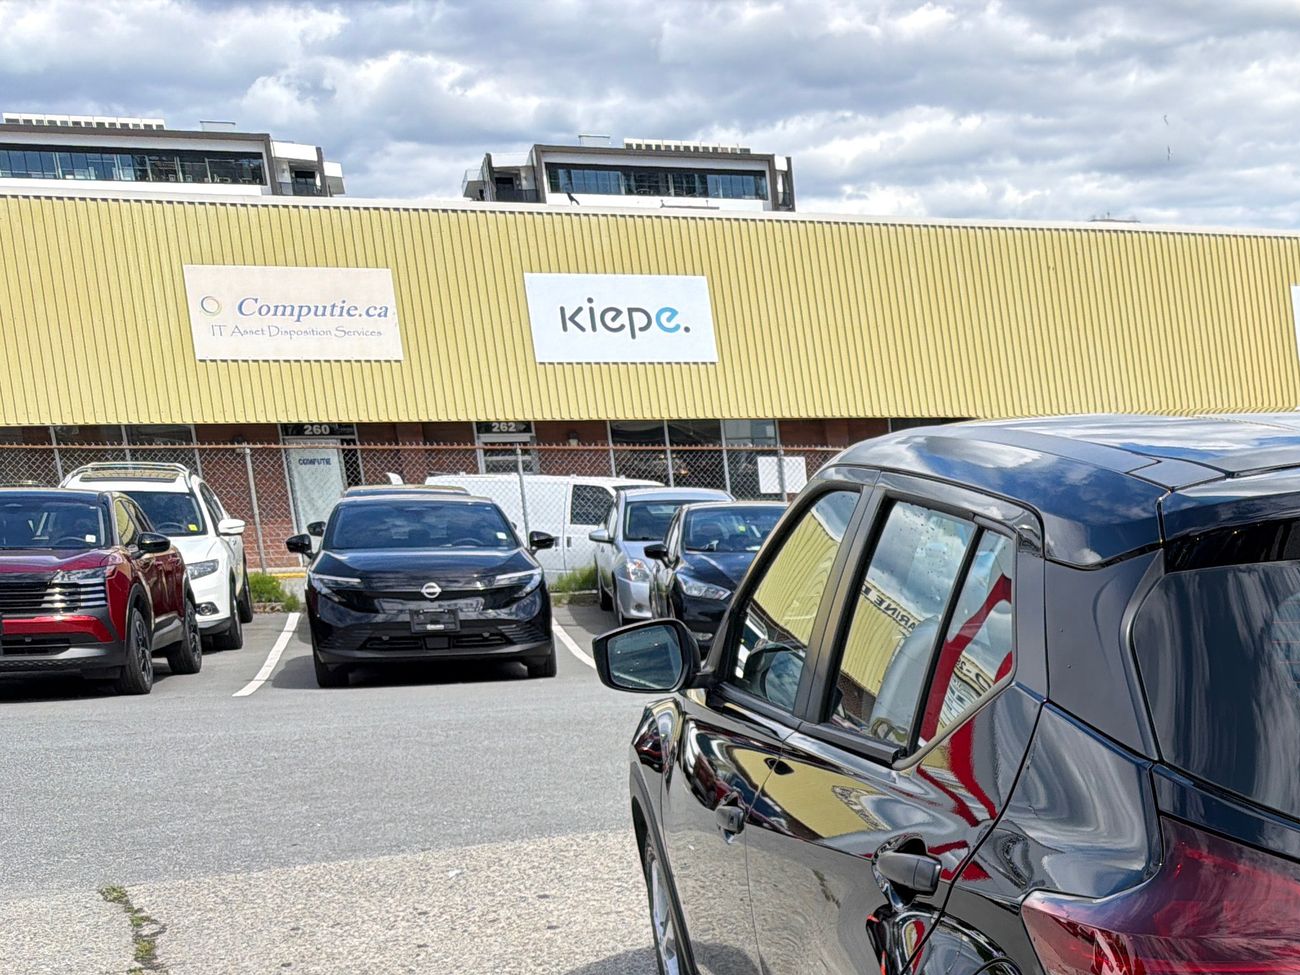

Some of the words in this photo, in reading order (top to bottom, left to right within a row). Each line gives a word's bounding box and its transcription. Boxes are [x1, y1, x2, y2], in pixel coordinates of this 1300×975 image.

[237, 297, 389, 323] Computie.ca
[211, 324, 227, 337] IT
[230, 324, 266, 337] Asset
[268, 324, 332, 340] Disposition
[334, 325, 383, 338] Services
[303, 424, 331, 435] 260
[491, 422, 517, 432] 262
